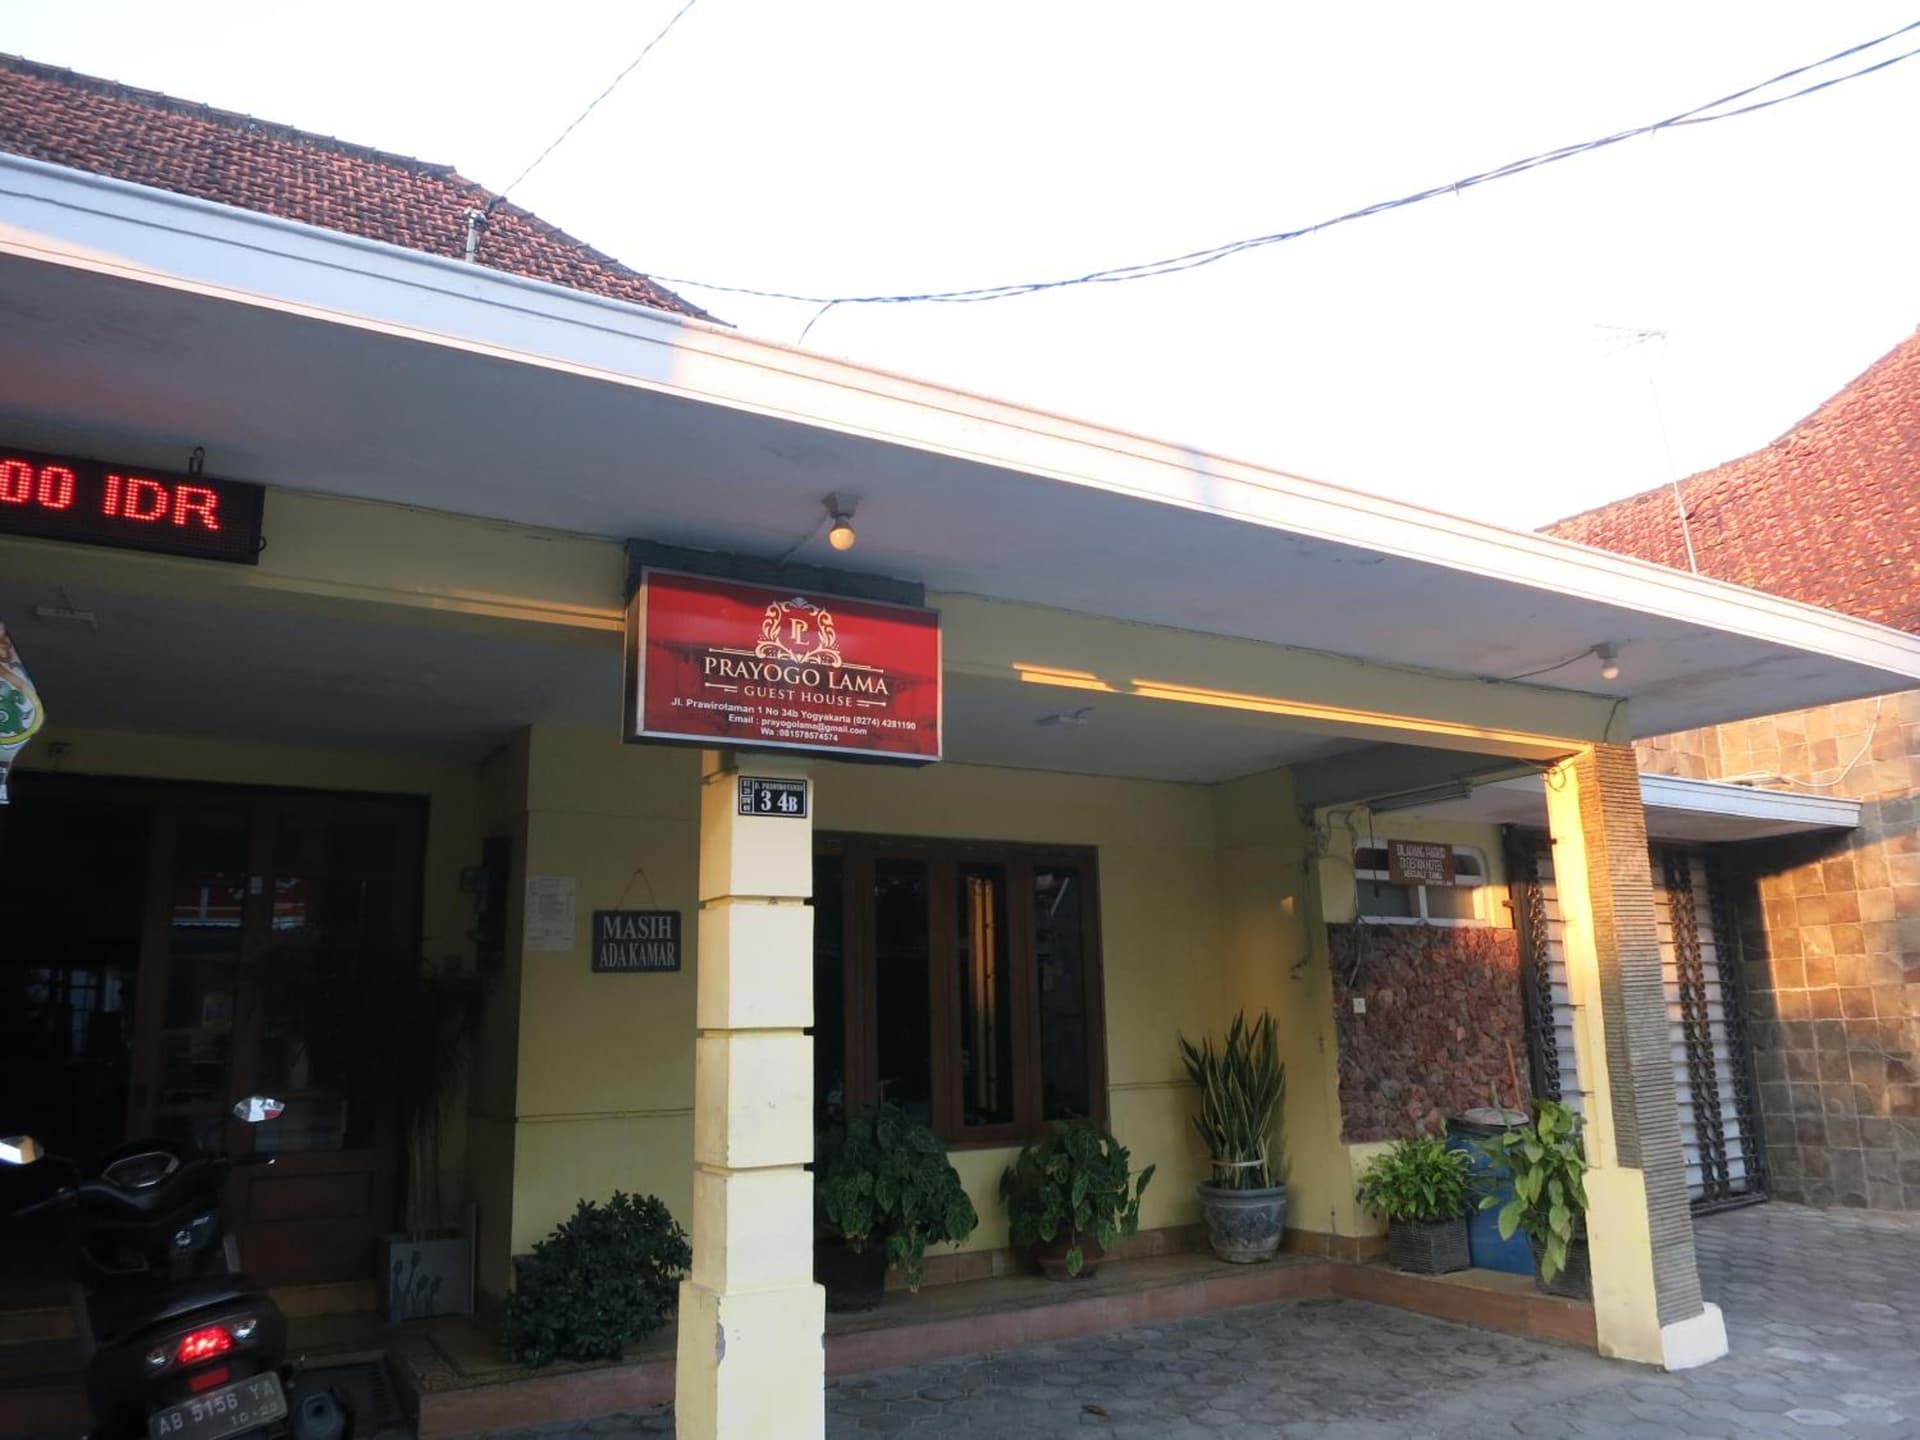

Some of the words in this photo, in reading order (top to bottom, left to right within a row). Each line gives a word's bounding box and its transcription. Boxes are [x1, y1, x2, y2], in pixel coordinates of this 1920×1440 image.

[103, 475, 220, 532] IDR
[704, 656, 820, 687] PRAYOGO
[829, 671, 889, 696] LAMA
[744, 685, 796, 701] GUEST
[802, 691, 854, 708] HOUSE
[686, 698, 756, 714] Prawirotaman
[765, 707, 779, 716] No
[801, 710, 852, 724] Yogyakarta
[728, 714, 754, 725] Email
[602, 915, 673, 940] MASIH
[600, 942, 627, 968] ADA
[628, 941, 677, 967] KAMAR
[159, 1412, 184, 1436] AB
